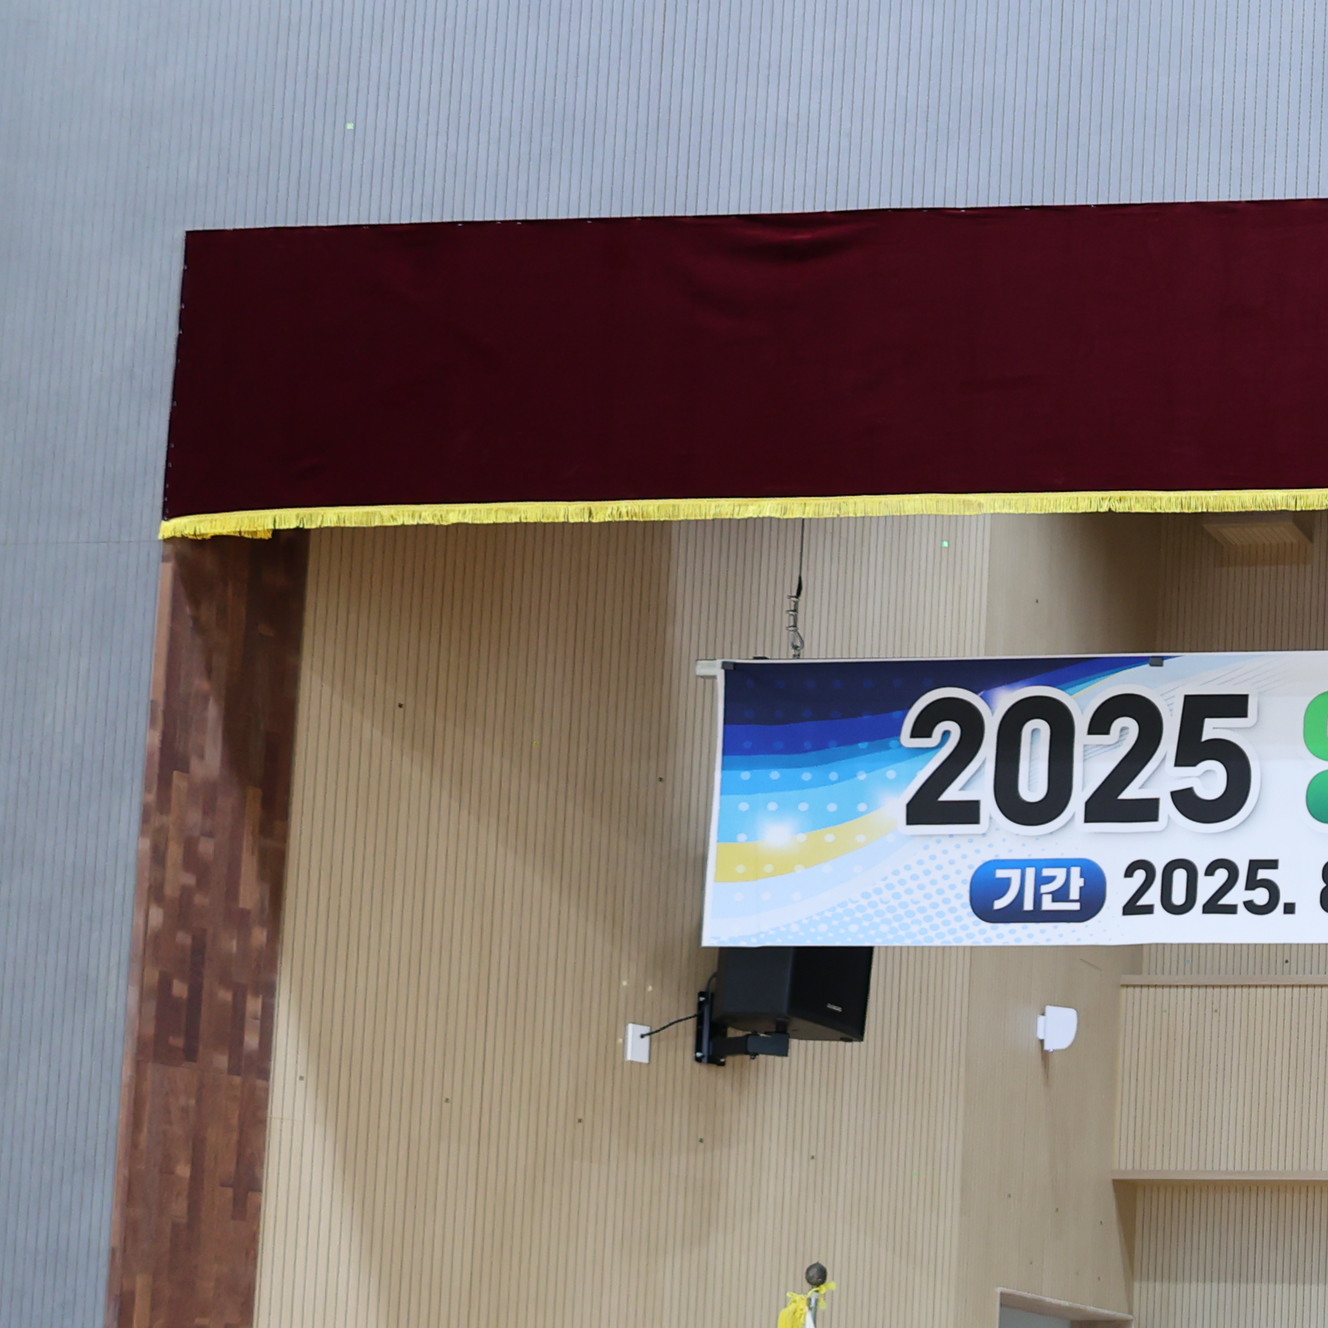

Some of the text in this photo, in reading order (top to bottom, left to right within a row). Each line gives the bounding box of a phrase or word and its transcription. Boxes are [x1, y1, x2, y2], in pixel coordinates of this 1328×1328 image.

[902, 692, 1253, 828] 2025
[991, 864, 1084, 912] 기간
[1122, 858, 1296, 916] 2025.
